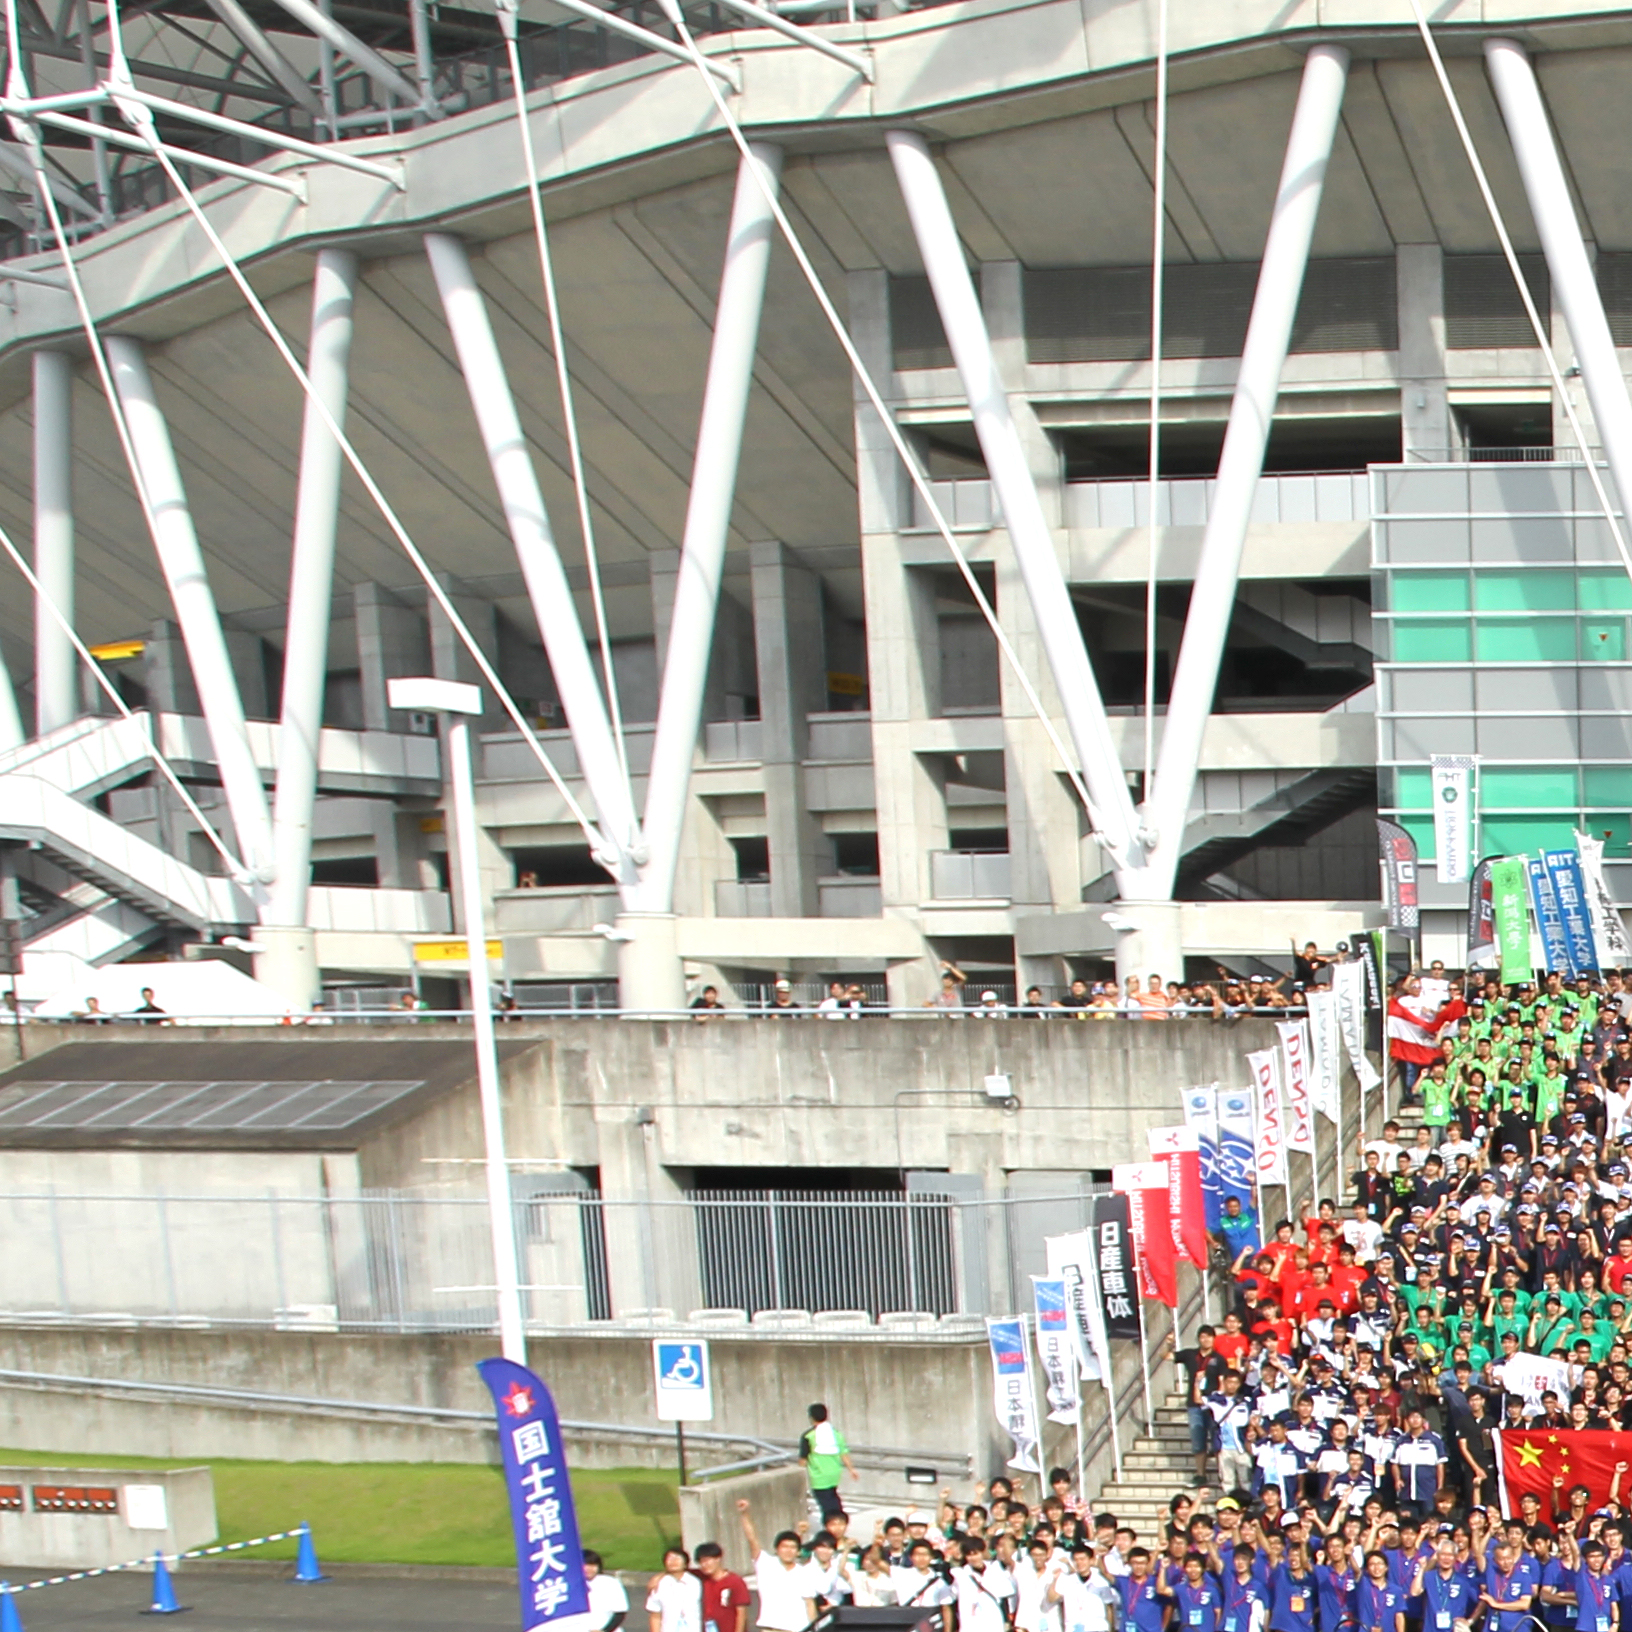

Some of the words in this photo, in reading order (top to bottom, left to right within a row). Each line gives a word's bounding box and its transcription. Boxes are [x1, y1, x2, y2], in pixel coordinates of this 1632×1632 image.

[1100, 1220, 1132, 1319] 日産車体
[511, 1419, 570, 1616] 国士舘大学
